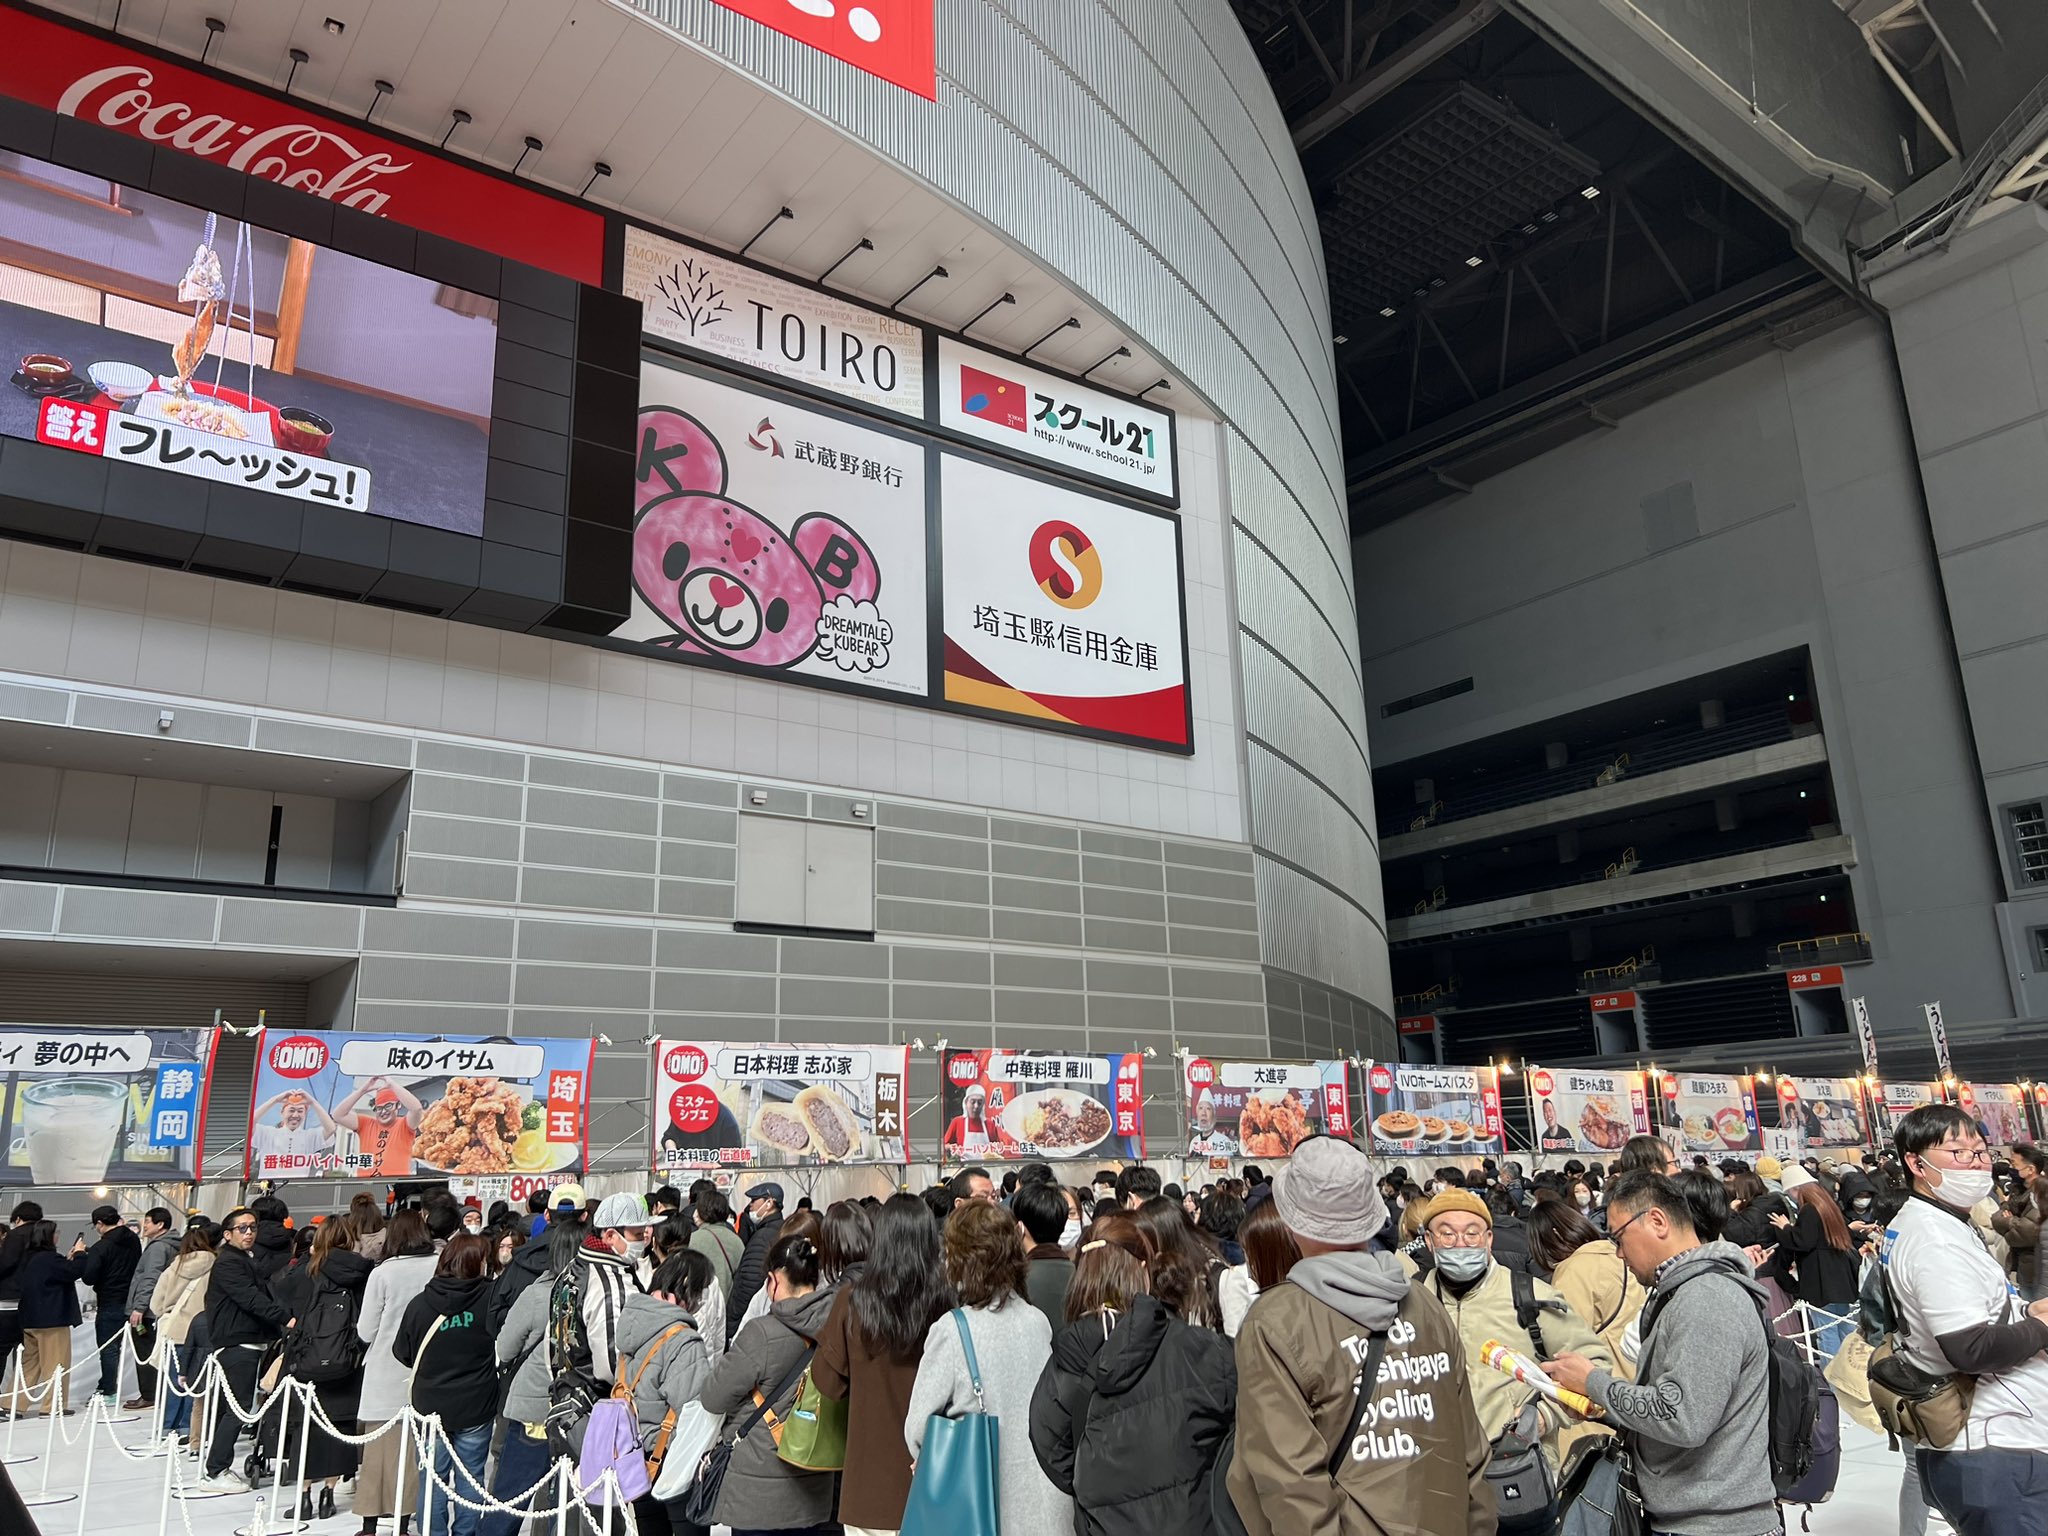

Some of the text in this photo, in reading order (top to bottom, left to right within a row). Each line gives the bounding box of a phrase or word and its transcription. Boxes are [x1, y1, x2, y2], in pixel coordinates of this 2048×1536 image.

[57, 65, 413, 218] Coca-Cola
[709, 331, 746, 347] BUSINESS
[748, 299, 897, 392] TOIRO
[45, 403, 99, 448] 答え
[1007, 413, 1025, 424] SCHOOL
[1007, 418, 1014, 426] 21
[1034, 393, 1155, 459] スクール21
[794, 439, 903, 488] 武蔵野銀行
[814, 534, 859, 589] B
[824, 614, 888, 642] DREAMTALE
[973, 605, 1159, 671] 埼玉縣信用金庫
[834, 634, 879, 657] KUBEAR
[34, 1041, 131, 1066] 夢の中へ
[278, 1046, 319, 1069] OMO
[387, 1047, 494, 1071] 味のイサム
[734, 1055, 852, 1075] 日本料理 志ぶ家
[1005, 1061, 1061, 1079] 中華料理
[1254, 1068, 1287, 1084] 大進亭
[155, 1069, 194, 1140] 静岡
[549, 1074, 578, 1138] 埼玉
[675, 1096, 714, 1108] ミスター
[878, 1078, 898, 1131] 栃木
[1117, 1082, 1135, 1131] 東京
[1327, 1087, 1345, 1131] 東京
[1484, 1092, 1500, 1132] 東京
[666, 1149, 751, 1162] 日本料理の伝道師
[1387, 1317, 1416, 1344] de
